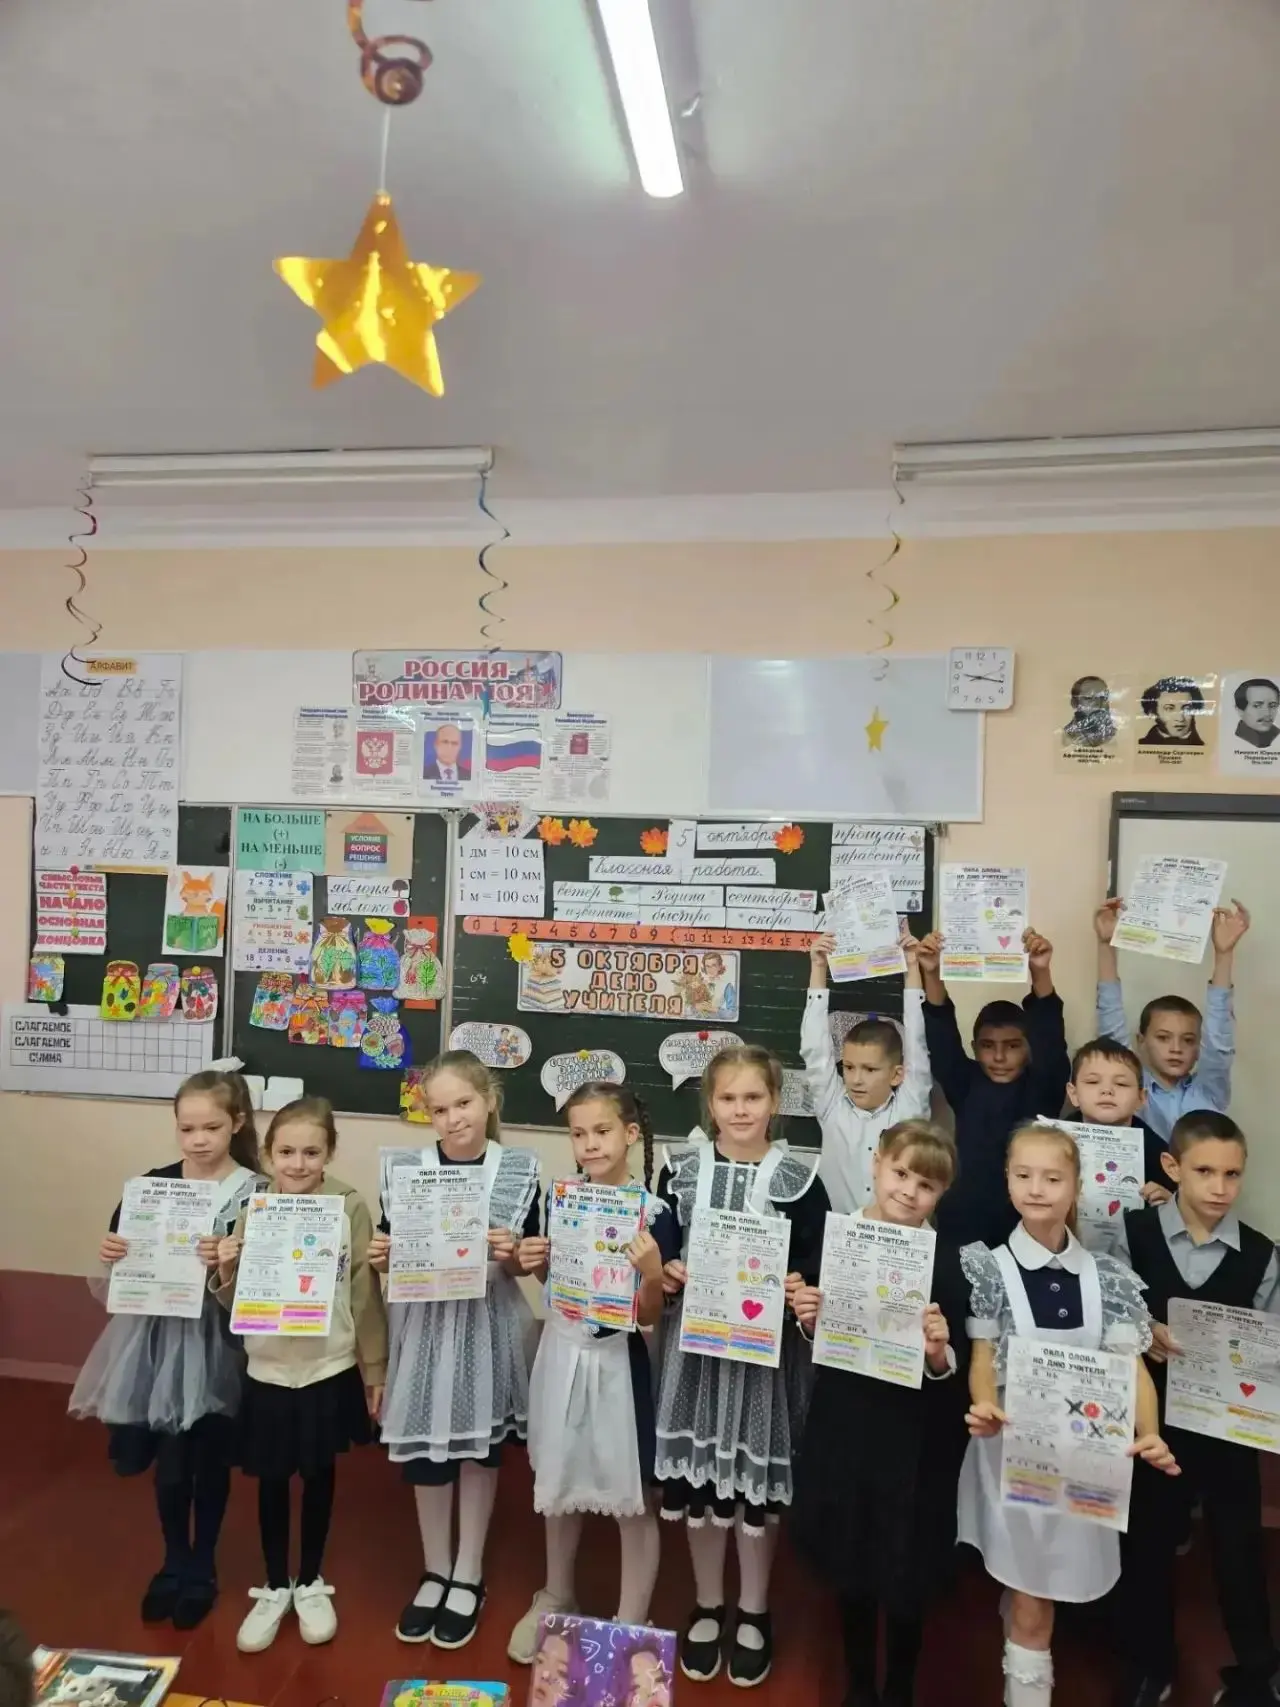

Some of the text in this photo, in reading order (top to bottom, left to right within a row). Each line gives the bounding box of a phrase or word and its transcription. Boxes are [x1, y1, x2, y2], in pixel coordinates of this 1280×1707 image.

[359, 683, 466, 701] РОДИНА
[243, 813, 321, 825] НА БОЛЬШЕ
[676, 828, 694, 848] 5
[834, 824, 906, 846] прощай
[242, 842, 322, 855] НА МЕНЬШЕ
[350, 844, 381, 852] ВОПРОС
[460, 846, 464, 857] 1
[470, 848, 486, 858] дм
[506, 846, 519, 858] 10
[523, 849, 538, 858] см
[594, 856, 673, 876] Классная
[460, 868, 464, 879] 1
[470, 871, 486, 880] см
[504, 868, 518, 880] 10
[522, 872, 540, 880] мм
[40, 896, 106, 910] НАЧАЛО
[460, 890, 464, 902] 1
[470, 893, 478, 902] м
[497, 890, 518, 902] 100
[522, 894, 539, 903] см
[331, 898, 389, 912] яблоко
[38, 916, 104, 928] ОСНОВНАЯ
[652, 908, 712, 927] быстро
[748, 912, 792, 930] скоро
[473, 920, 480, 930] 0
[493, 920, 498, 932] 1
[512, 922, 518, 934] 2
[530, 924, 538, 934] 3
[550, 926, 558, 936] 4
[570, 926, 578, 938] 5
[590, 928, 597, 938] 6
[610, 928, 618, 940] 7
[630, 928, 638, 939] 8
[650, 929, 658, 941] 9
[702, 934, 713, 943] 11
[722, 936, 732, 944] 12
[742, 937, 754, 945] 13
[780, 938, 792, 947] 15
[38, 935, 104, 946] КОНЦОВКА
[550, 949, 699, 975] 5 ОКТЯБРЯ
[590, 971, 657, 992] ДЕНЬ
[562, 990, 683, 1015] УЧИТЕЛЯ
[16, 1021, 72, 1032] СЛАГАЕМОЕ
[15, 1036, 71, 1048] СЛАГАЕМОЕ
[29, 1052, 62, 1063] СУММА
